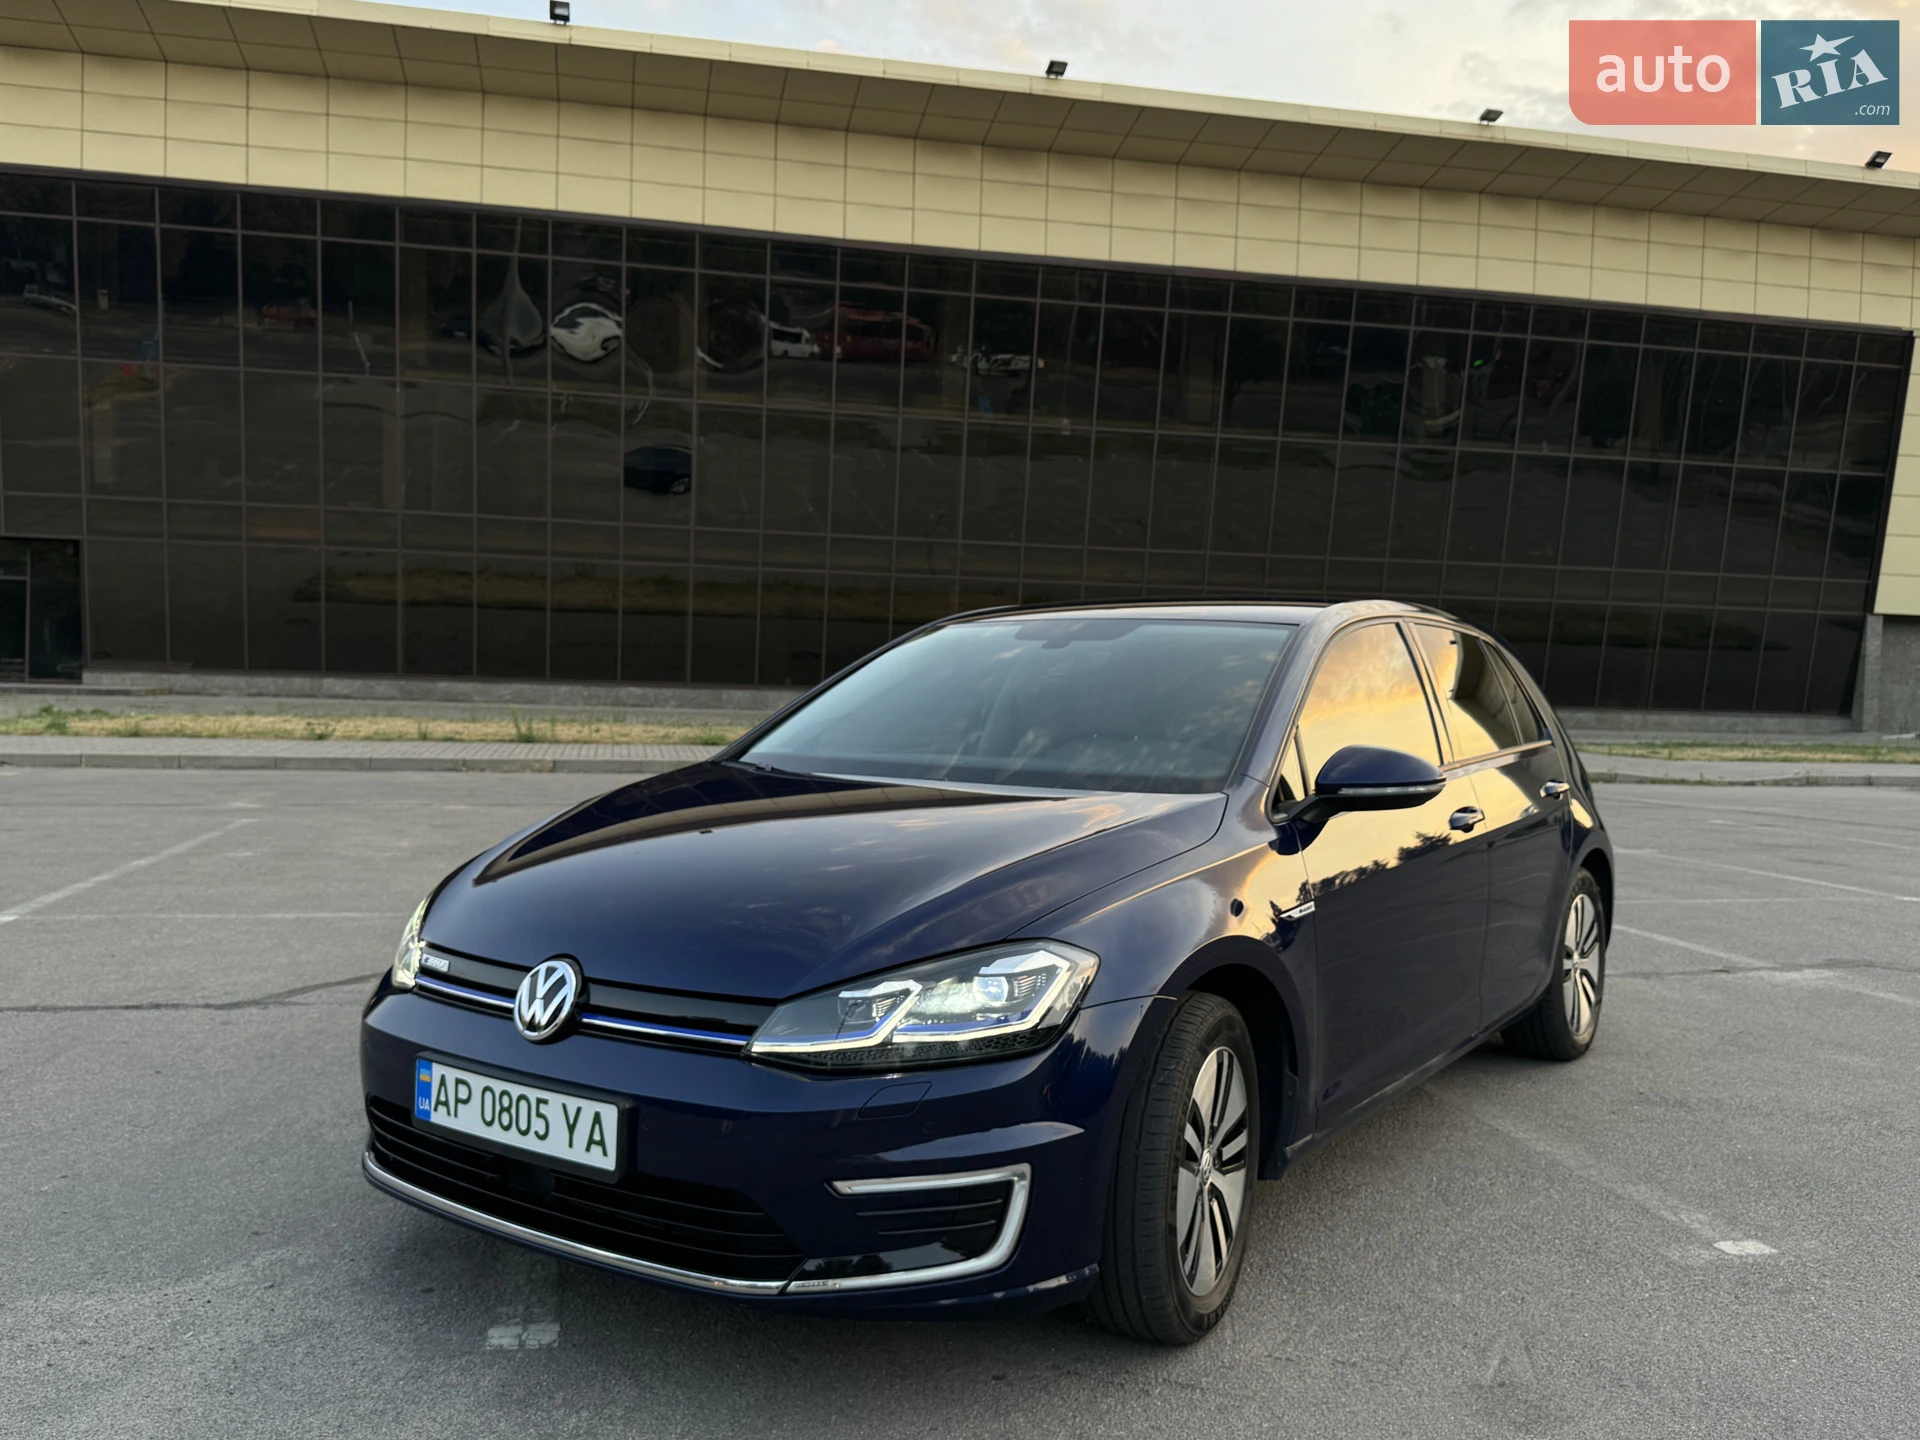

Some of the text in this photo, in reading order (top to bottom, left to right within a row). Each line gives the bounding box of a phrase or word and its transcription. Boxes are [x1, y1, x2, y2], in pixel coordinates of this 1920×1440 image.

[418, 1096, 430, 1111] UA
[433, 1073, 608, 1157] AP 0805 YA
